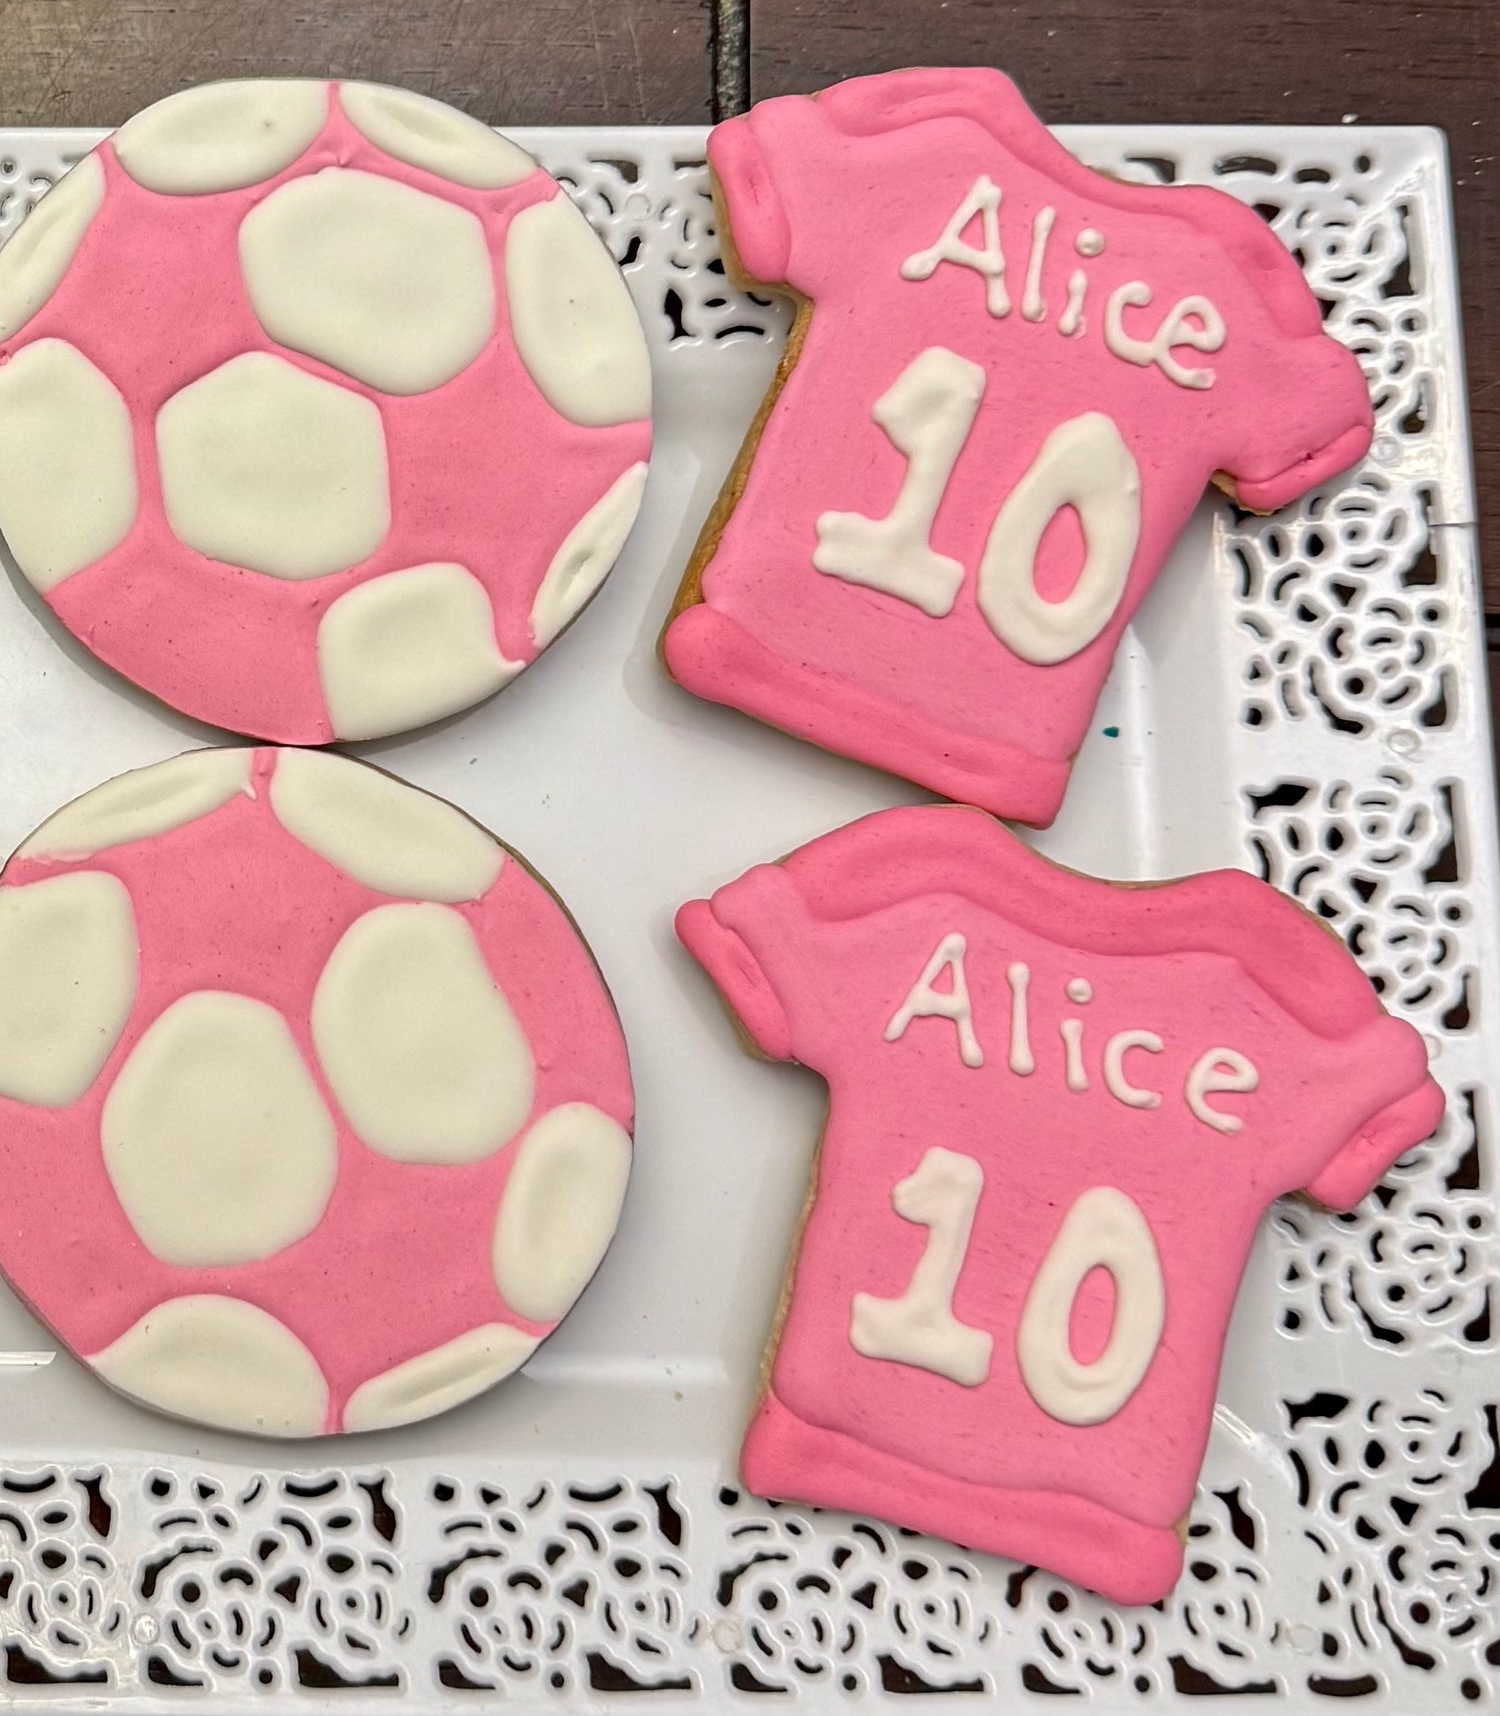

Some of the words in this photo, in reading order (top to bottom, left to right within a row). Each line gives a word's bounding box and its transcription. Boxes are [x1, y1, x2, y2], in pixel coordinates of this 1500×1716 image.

[901, 177, 1225, 387] Alice
[813, 346, 1140, 664] 10
[884, 933, 1259, 1131] Alice
[850, 1146, 1162, 1424] 10
